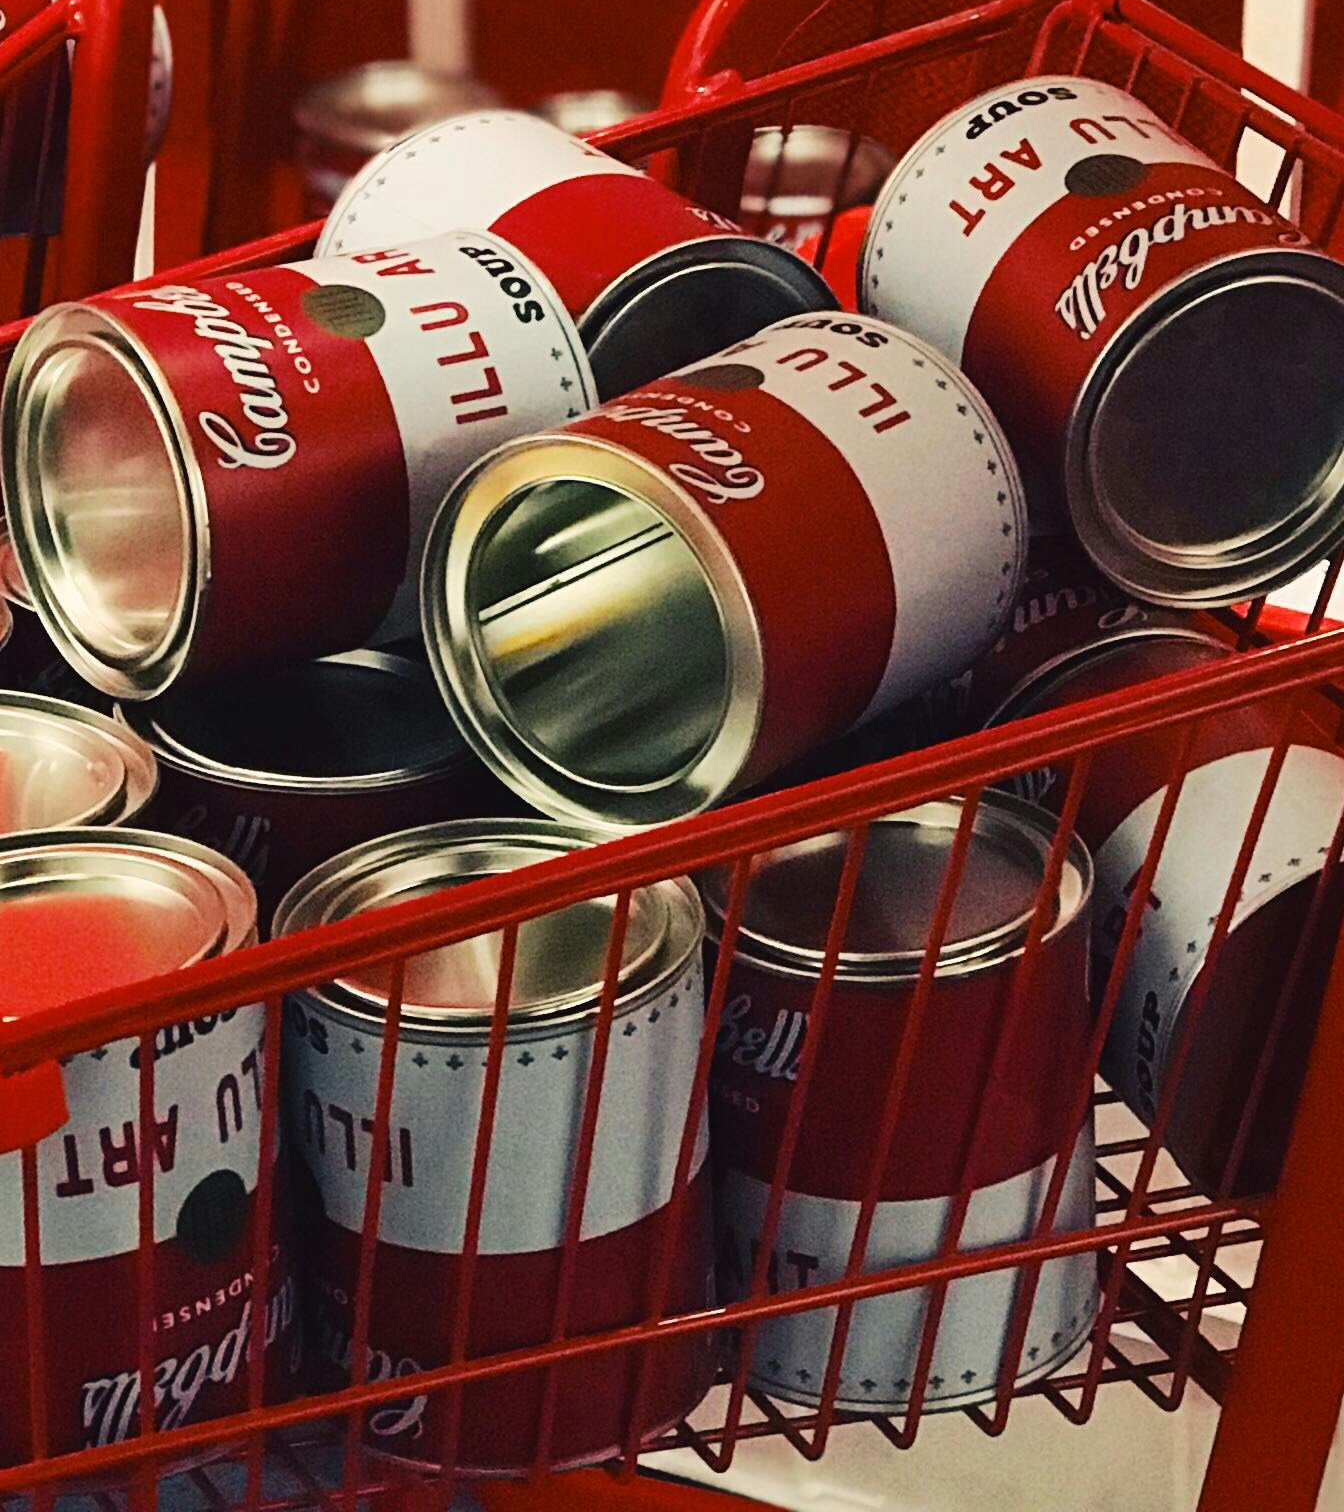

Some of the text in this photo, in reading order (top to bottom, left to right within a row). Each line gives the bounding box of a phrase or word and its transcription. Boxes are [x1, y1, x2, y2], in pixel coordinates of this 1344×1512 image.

[965, 86, 1078, 140] SOUP
[949, 138, 1043, 238] ART
[1068, 188, 1224, 251] CONDENSED
[459, 245, 546, 324] SOUP
[225, 281, 321, 395] CONDENSED
[409, 301, 509, 425] ILLU
[776, 347, 912, 434] ILLU
[56, 1103, 179, 1198] ART
